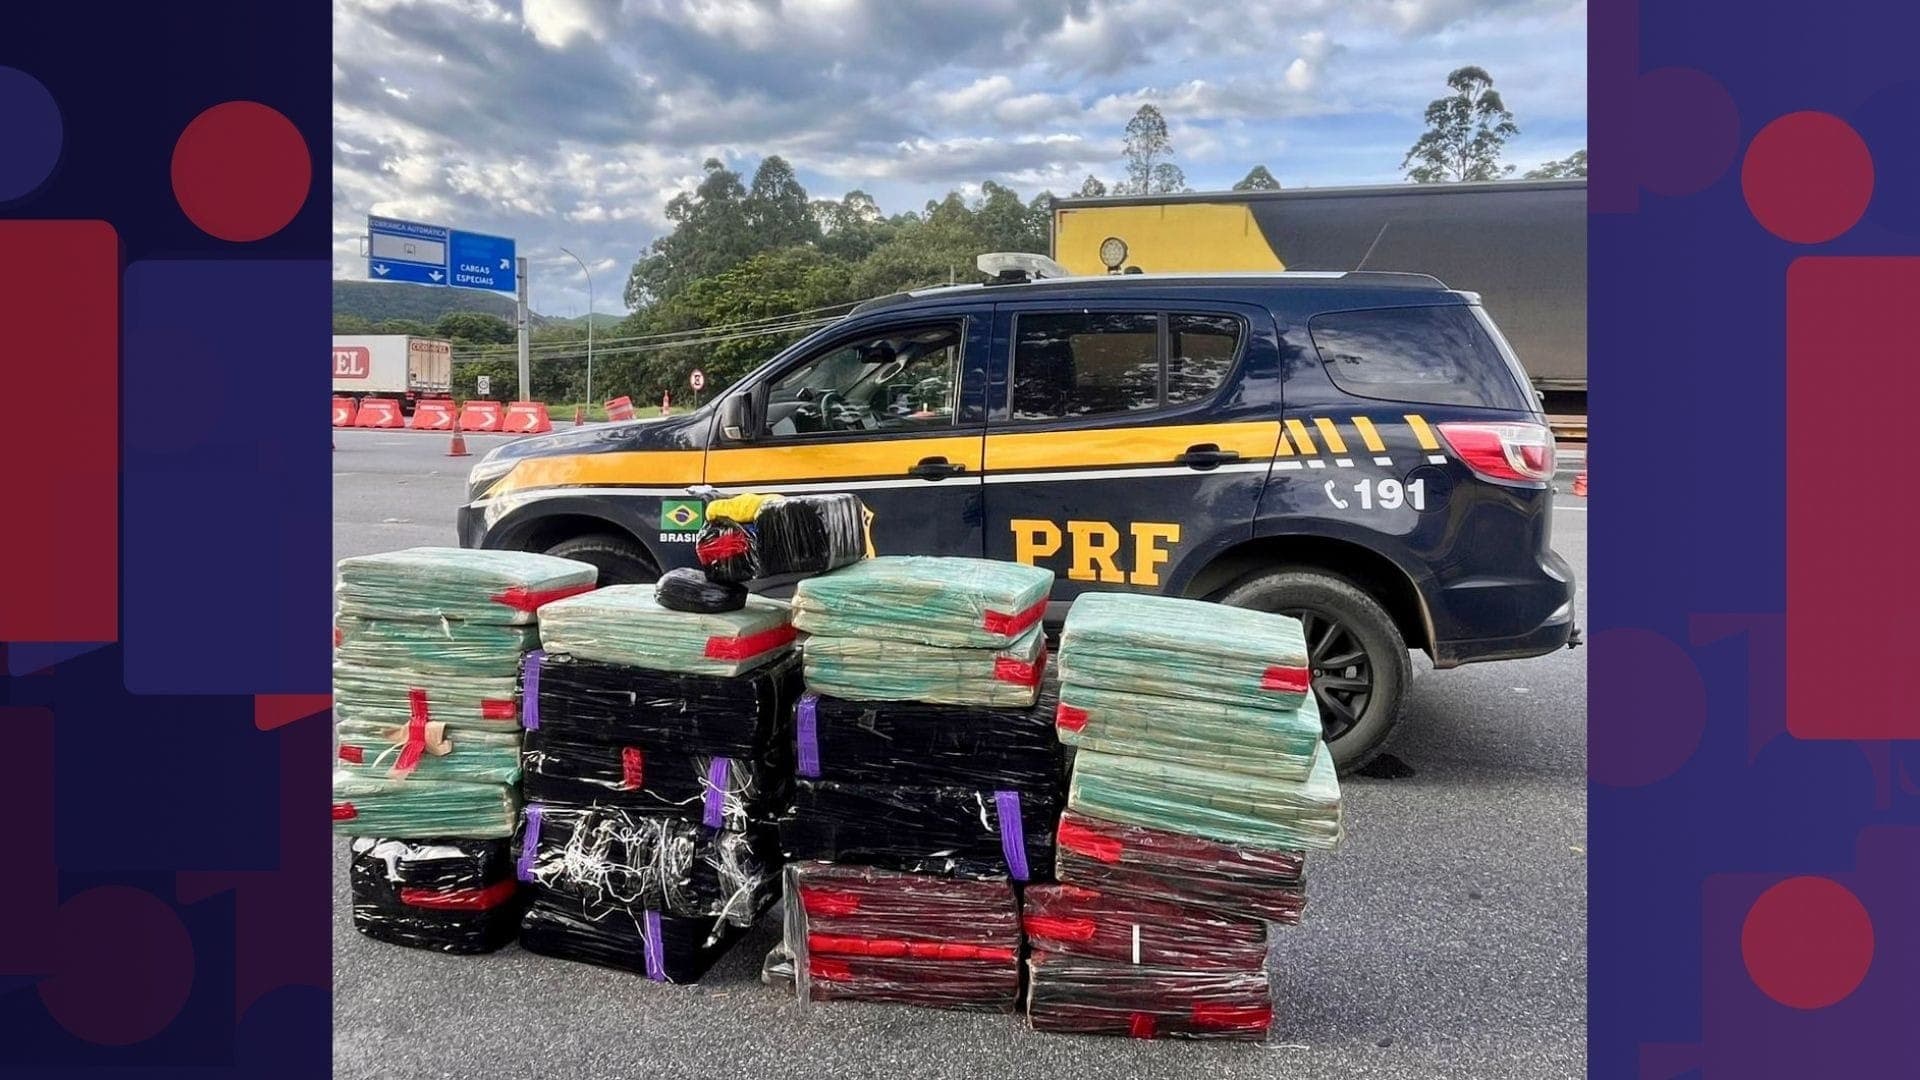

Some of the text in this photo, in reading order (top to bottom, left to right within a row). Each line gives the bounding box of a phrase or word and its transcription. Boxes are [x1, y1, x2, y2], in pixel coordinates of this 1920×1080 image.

[456, 274, 494, 286] ESPECIAIS
[460, 264, 490, 275] CARGAS
[333, 351, 364, 375] EL
[1354, 479, 1425, 510] 191
[1010, 519, 1181, 586] PRF
